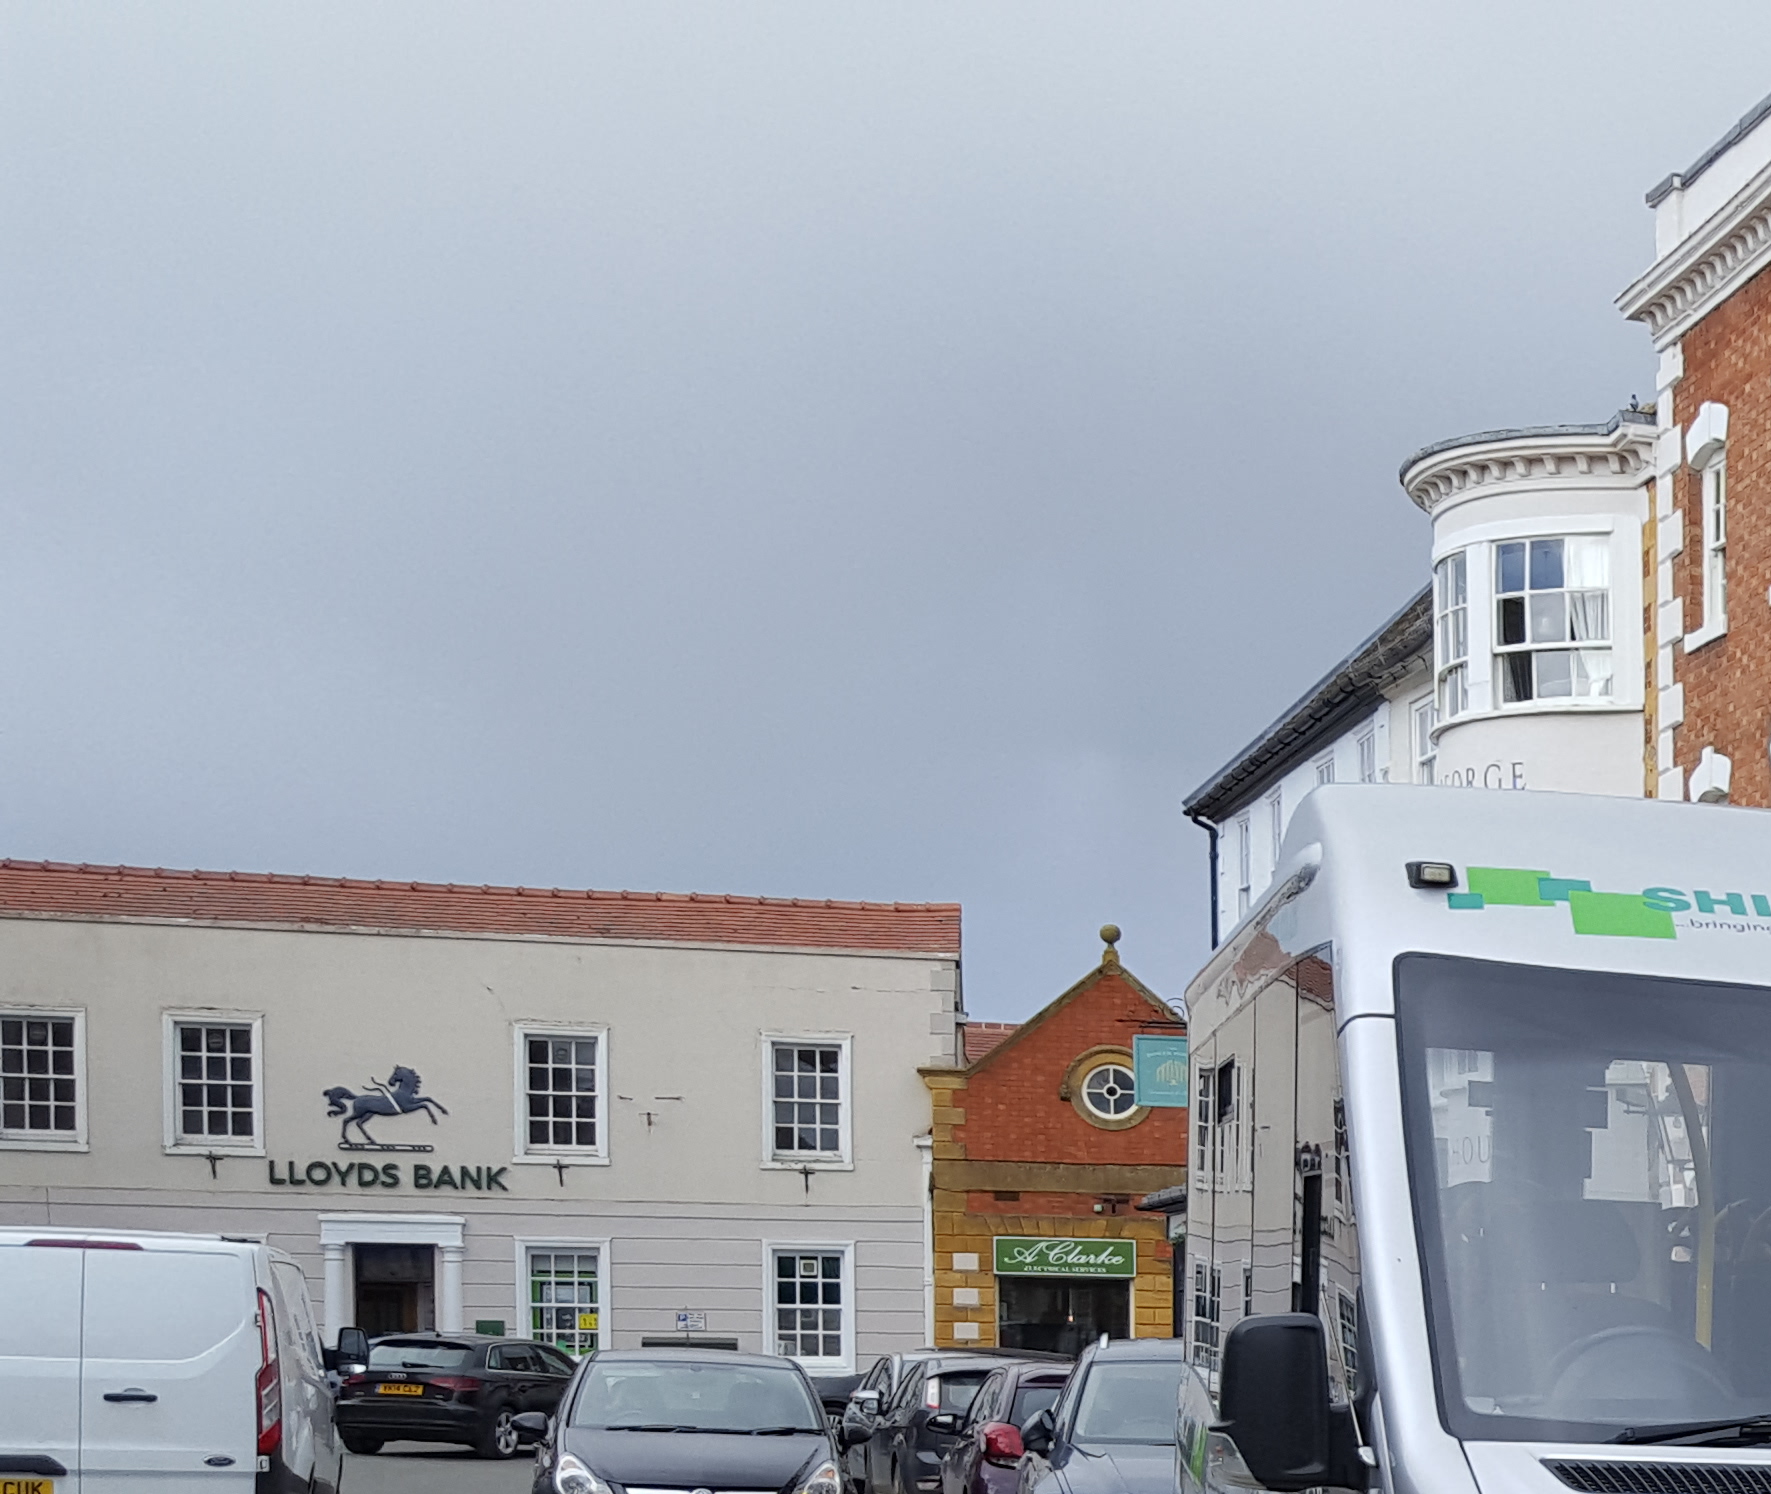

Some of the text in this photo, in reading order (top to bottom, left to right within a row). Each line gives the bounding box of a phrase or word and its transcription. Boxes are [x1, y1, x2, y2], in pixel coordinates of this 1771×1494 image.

[268, 1159, 509, 1192] LLOYDS BANK
[1042, 1241, 1126, 1265] Clarke
